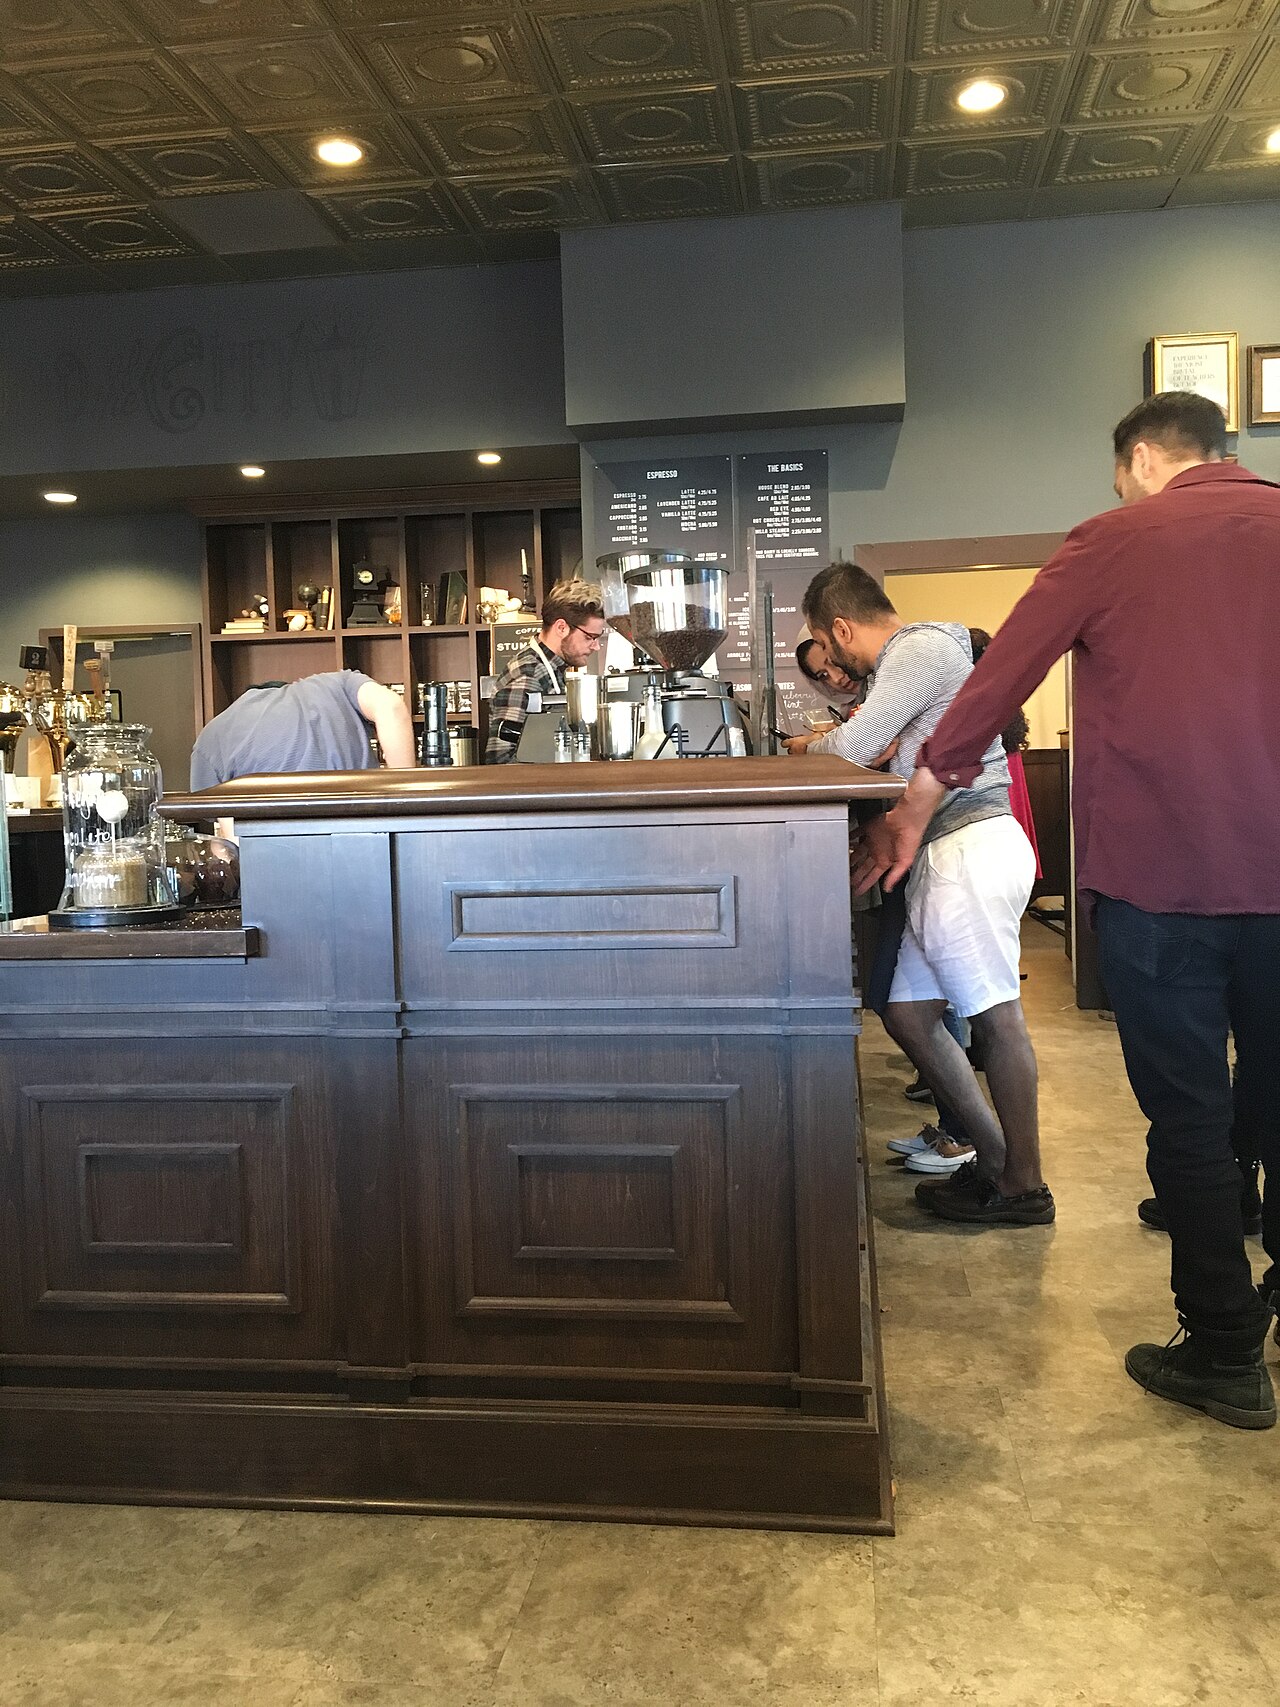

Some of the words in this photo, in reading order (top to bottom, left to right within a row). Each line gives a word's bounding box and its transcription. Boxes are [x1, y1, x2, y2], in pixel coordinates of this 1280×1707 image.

[780, 463, 803, 472] BASICS
[647, 470, 677, 479] ESPRESSO
[32, 652, 40, 665] 2
